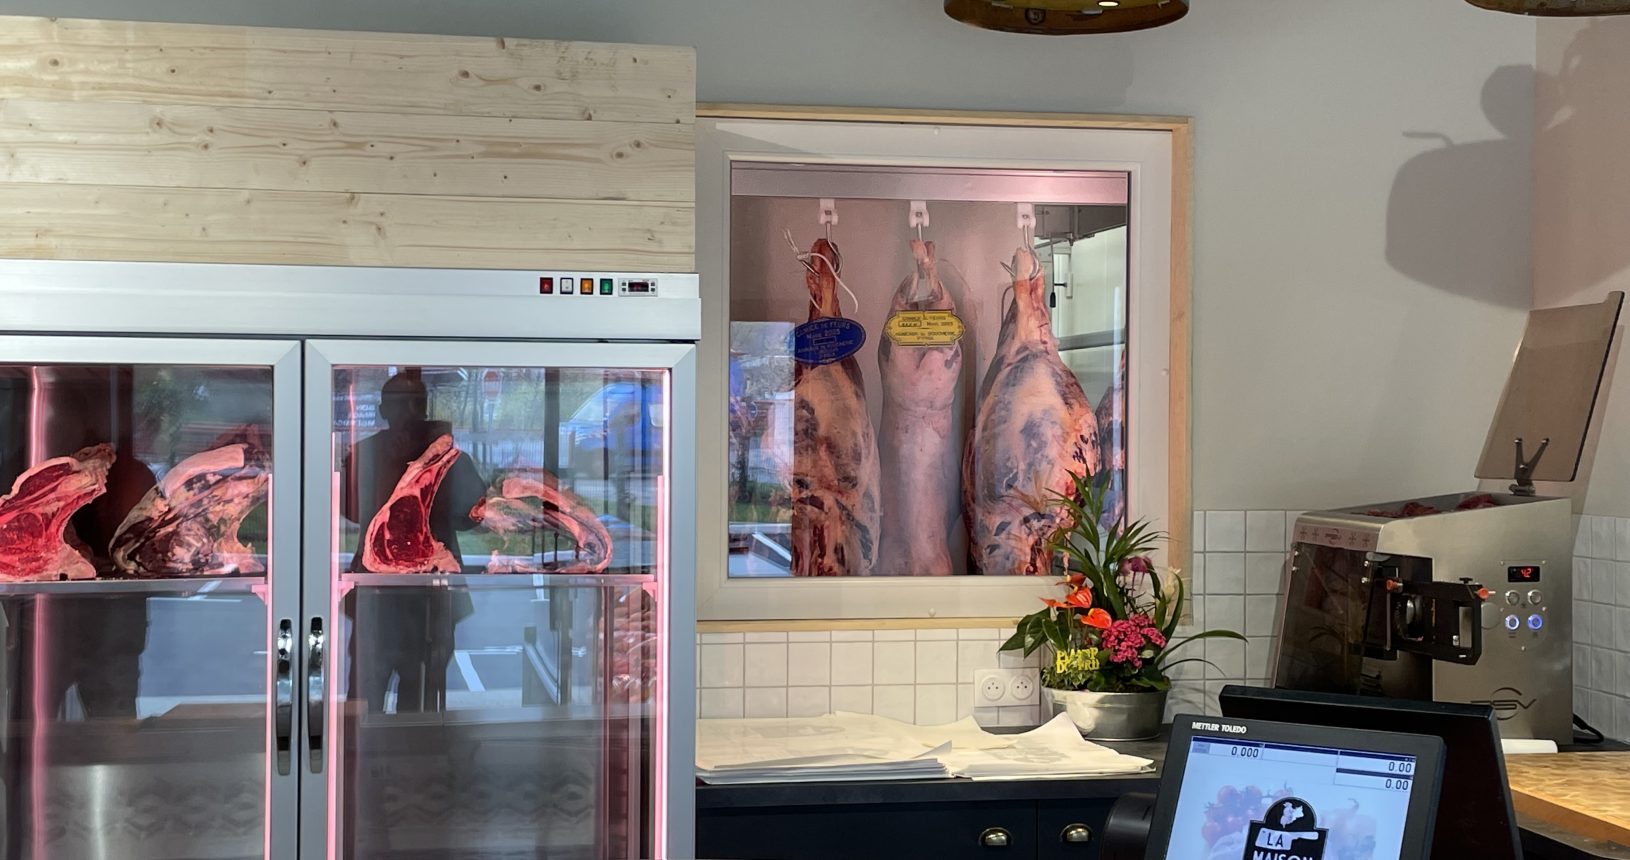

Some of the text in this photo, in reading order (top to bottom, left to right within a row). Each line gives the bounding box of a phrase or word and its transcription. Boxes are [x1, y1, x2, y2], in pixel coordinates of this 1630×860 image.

[1191, 721, 1247, 734] METTLER TOLEDO
[1231, 746, 1259, 758] 0.000
[1388, 761, 1412, 773] 0.00
[1385, 778, 1409, 791] 0.00
[1266, 832, 1284, 848] LA
[1252, 850, 1313, 860] MAIS
